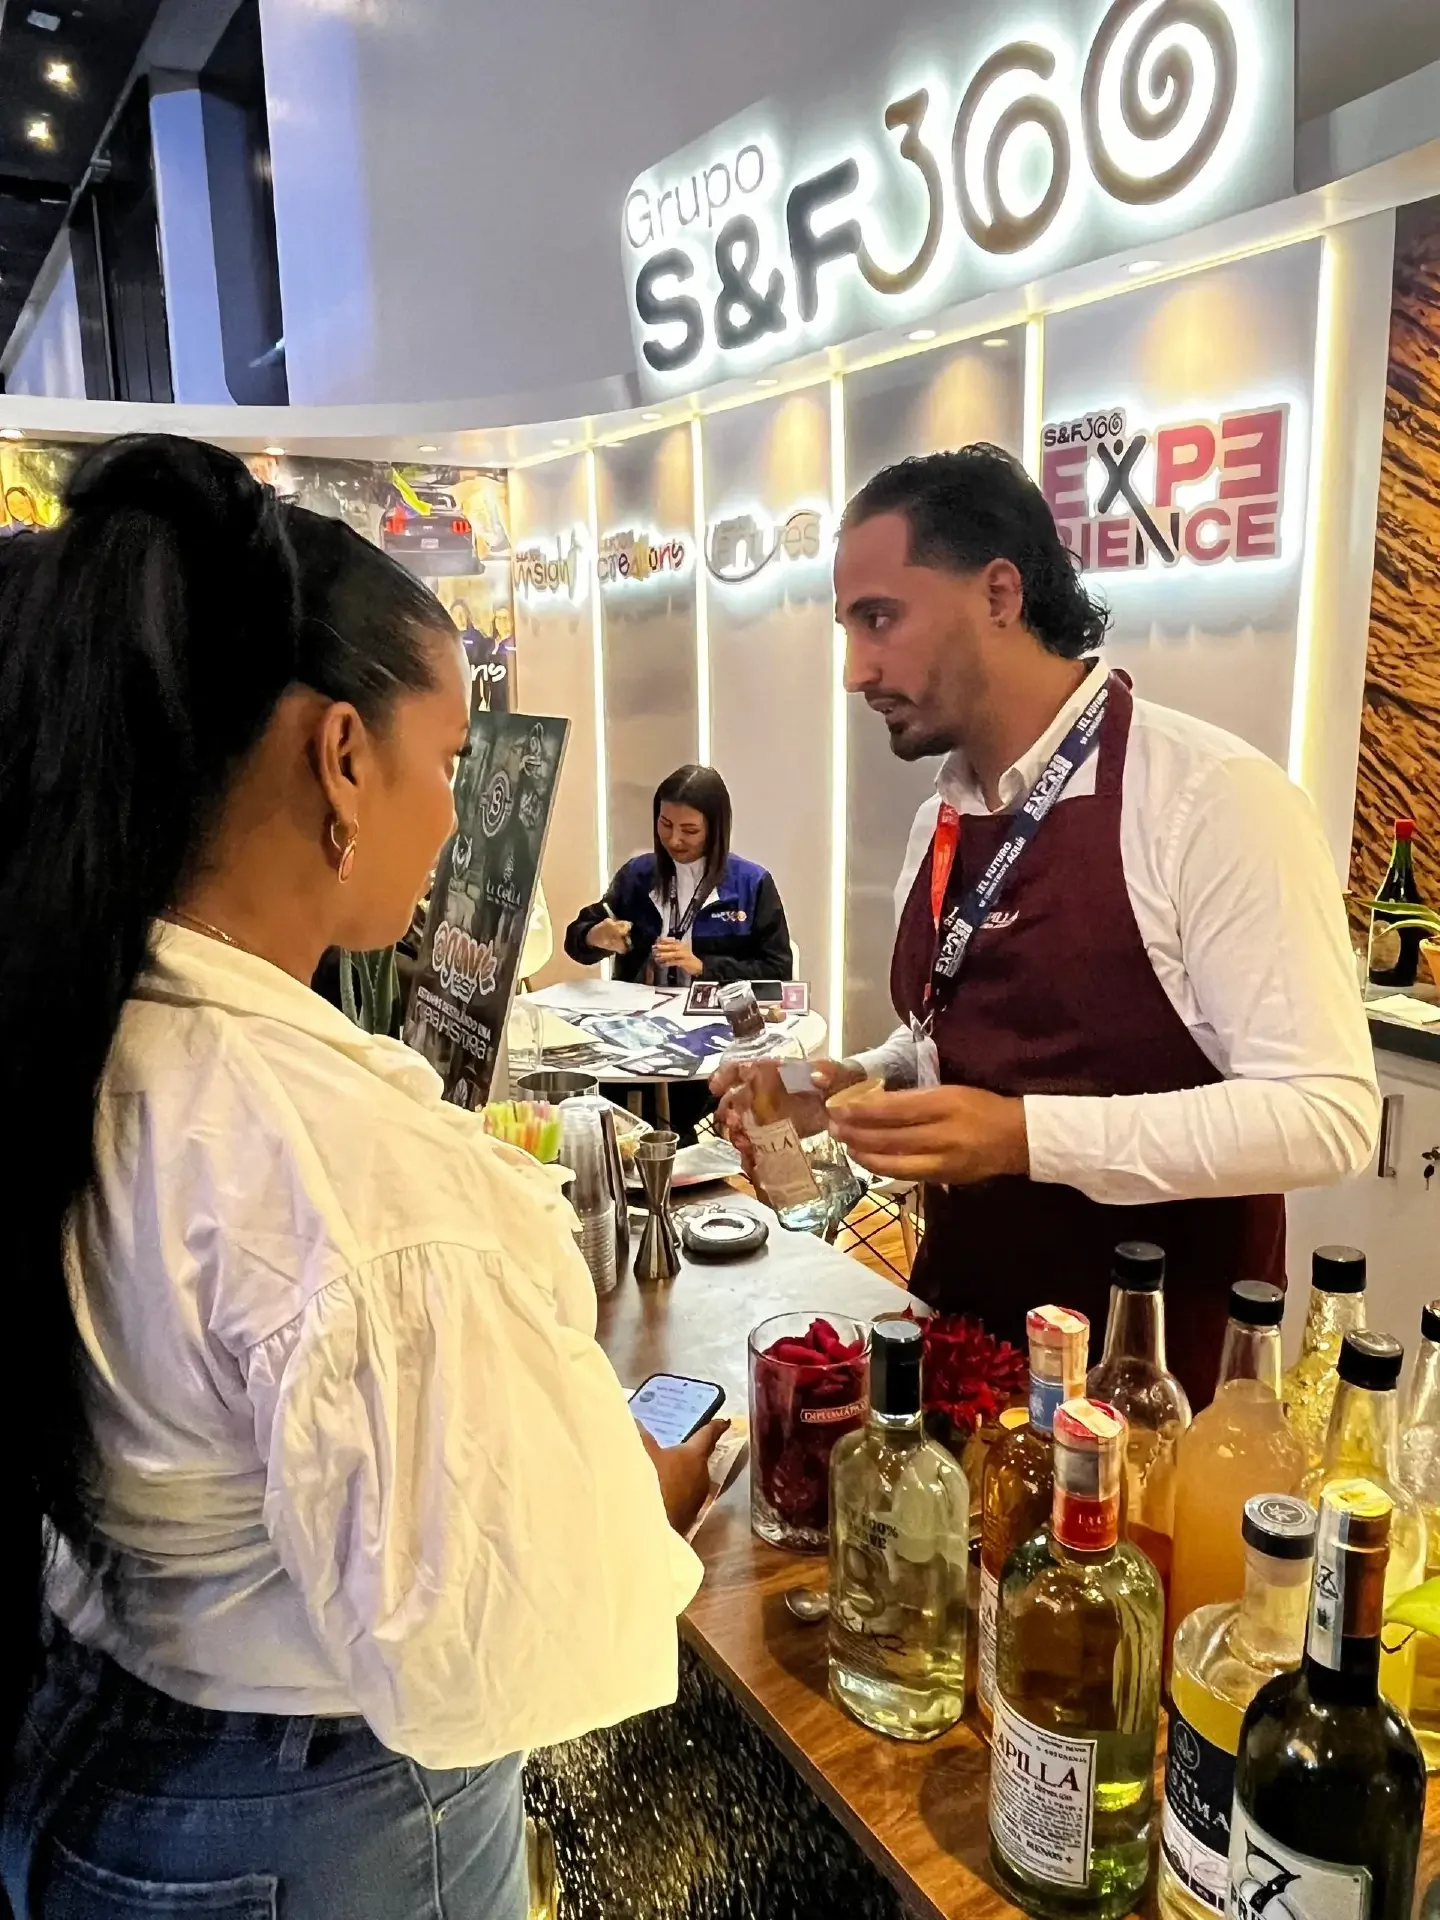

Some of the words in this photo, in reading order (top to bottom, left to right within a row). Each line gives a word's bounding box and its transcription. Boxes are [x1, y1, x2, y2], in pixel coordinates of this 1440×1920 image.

[625, 144, 765, 249] Grupo
[985, 842, 1012, 879] FUTURO
[995, 1733, 1081, 1793] APILLA
